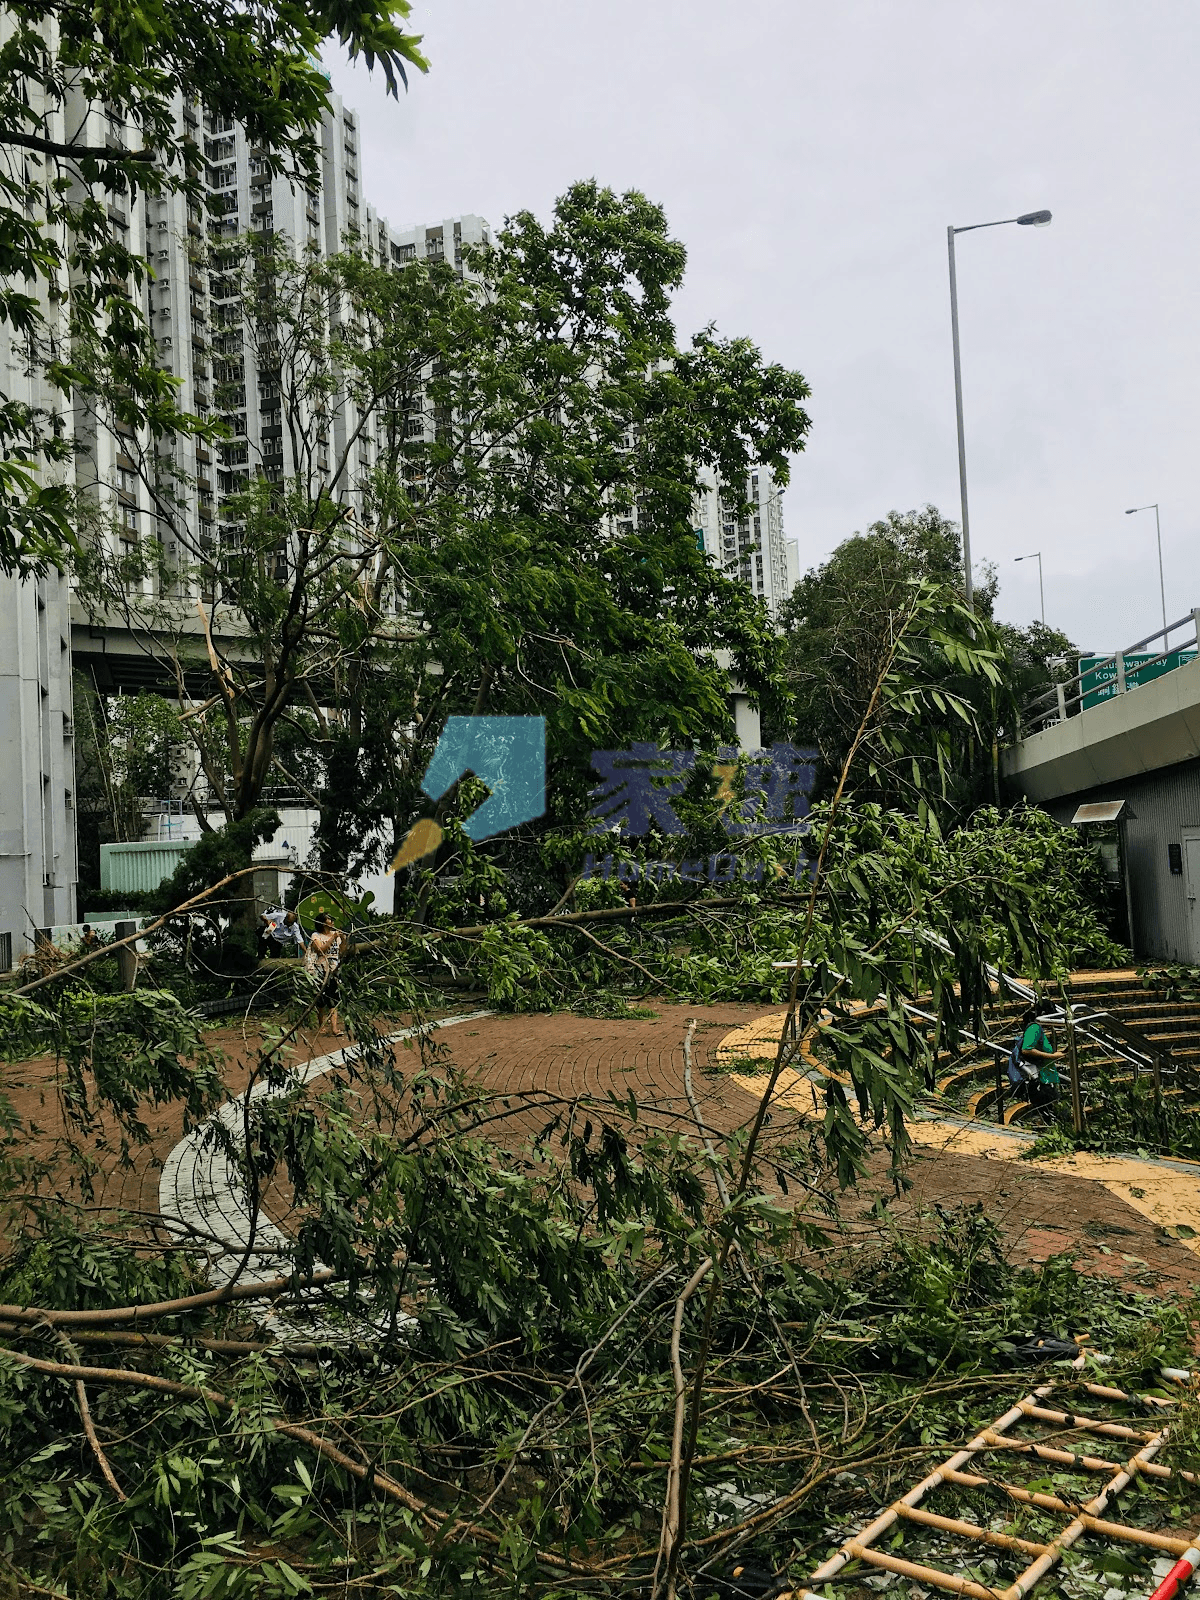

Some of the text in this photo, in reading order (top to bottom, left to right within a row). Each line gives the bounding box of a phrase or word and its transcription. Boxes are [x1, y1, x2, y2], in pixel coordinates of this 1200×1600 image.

[1095, 657, 1168, 670] Cauway ay
[1095, 671, 1140, 681] Kown
